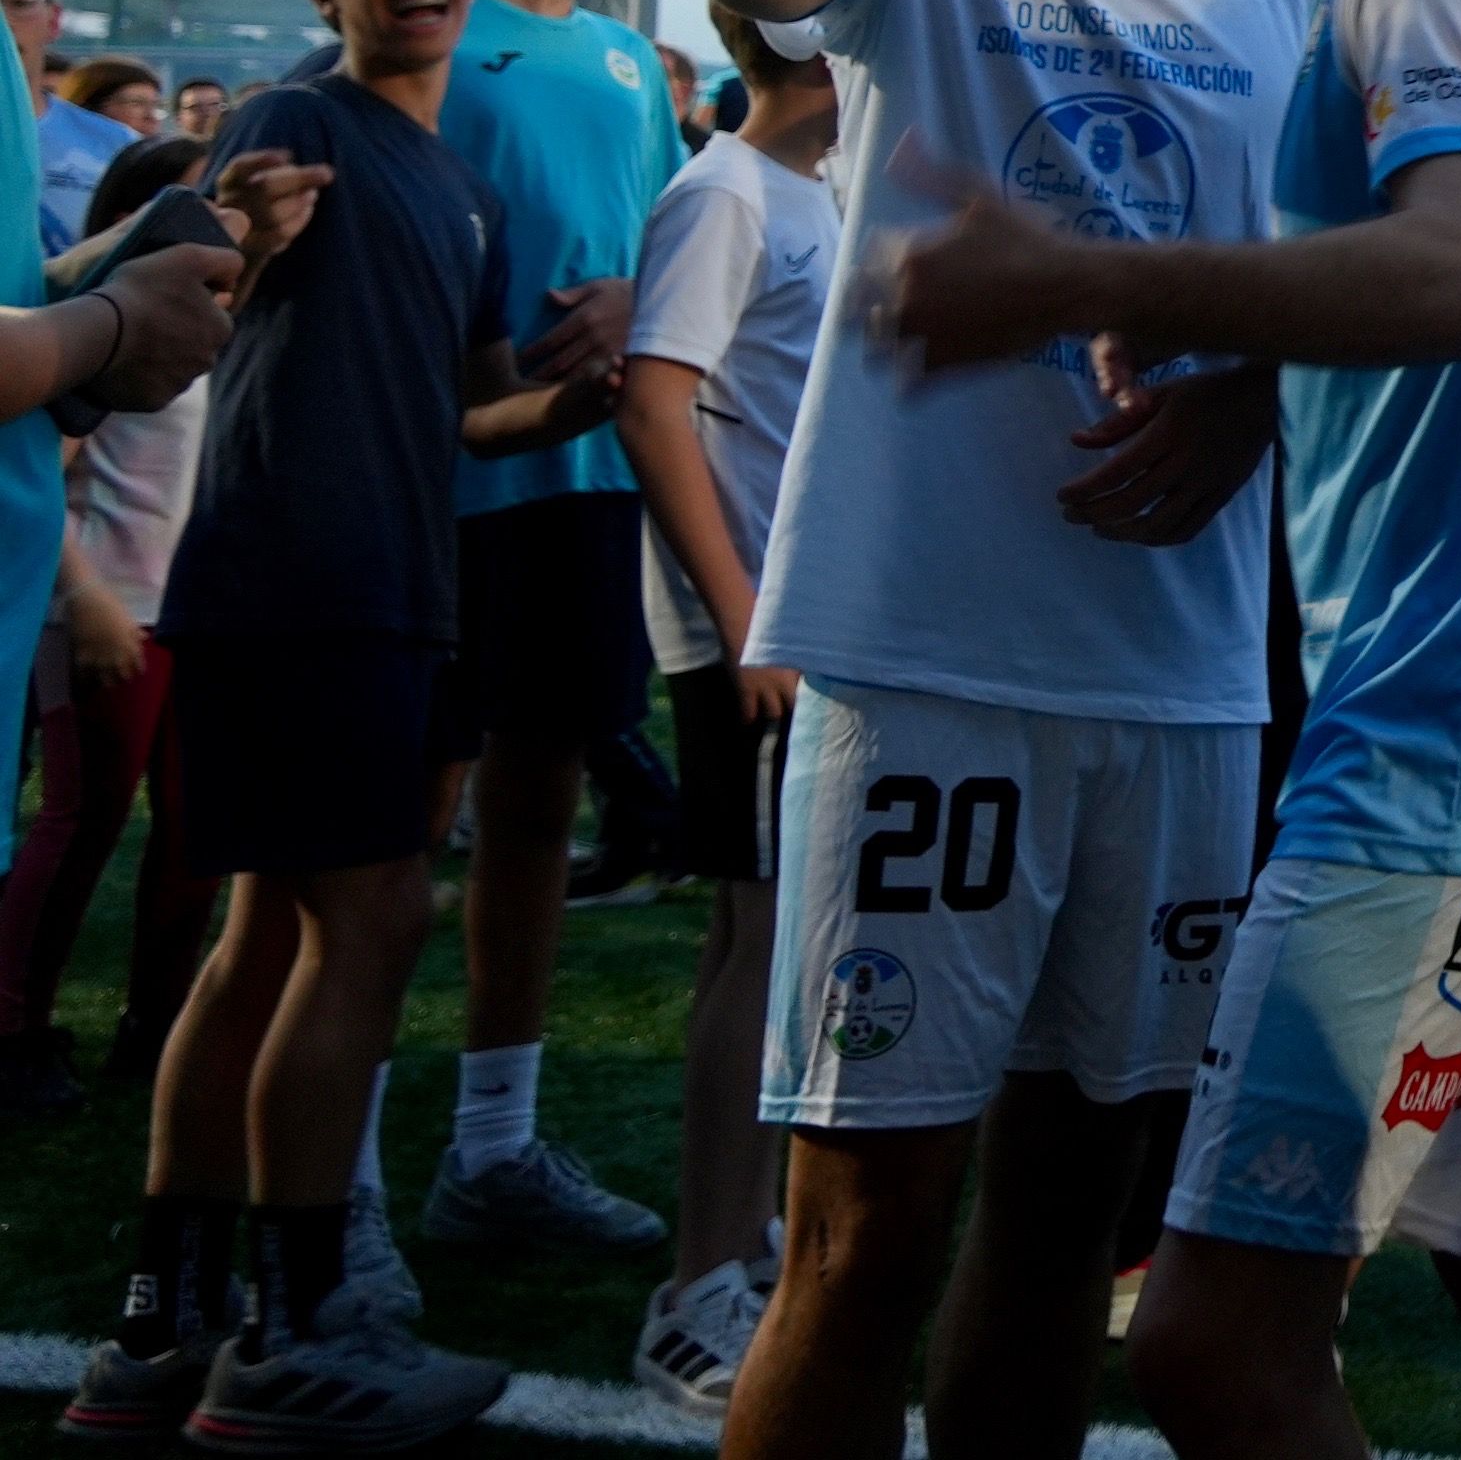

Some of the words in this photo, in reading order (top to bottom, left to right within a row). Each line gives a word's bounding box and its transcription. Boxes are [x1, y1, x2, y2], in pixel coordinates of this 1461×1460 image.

[1054, 46, 1082, 75] DE
[1120, 49, 1253, 97] FEDERACIÓN!
[855, 775, 1021, 913] 20
